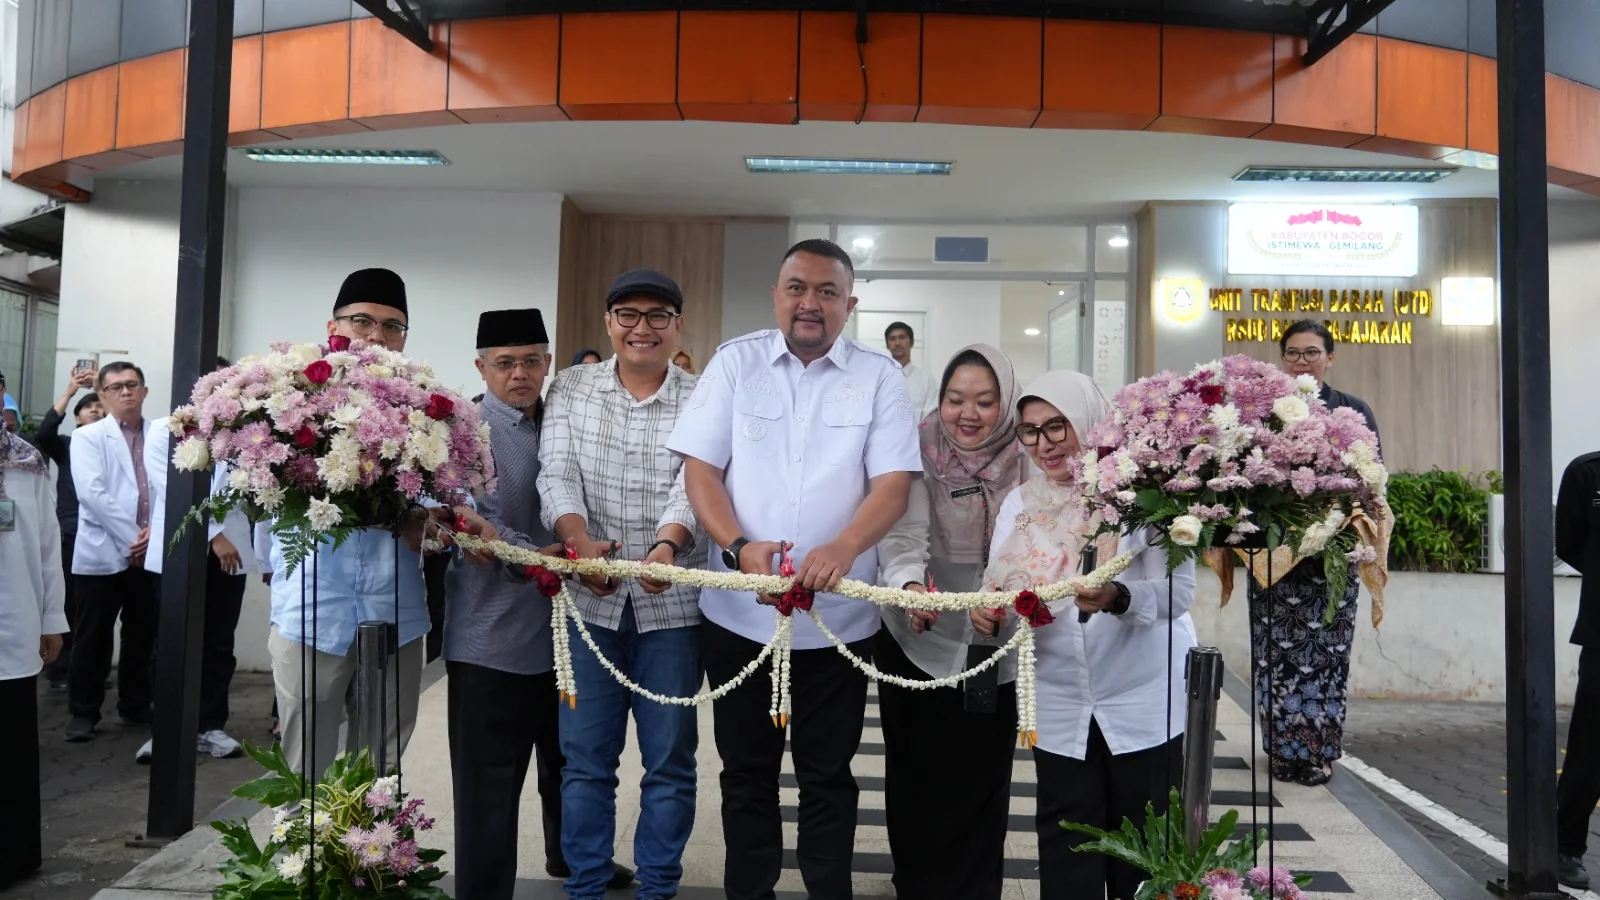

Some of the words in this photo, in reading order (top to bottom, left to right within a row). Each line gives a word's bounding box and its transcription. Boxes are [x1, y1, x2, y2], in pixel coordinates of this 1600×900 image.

[1270, 231, 1338, 240] KABUPATEN
[1341, 231, 1384, 241] BOGOR
[1267, 241, 1321, 249] ISTIMEWA
[1329, 241, 1384, 250] GEMILANG
[1209, 287, 1242, 312] UNIT
[1251, 288, 1325, 313] TRANFUSI
[1329, 288, 1384, 313] DARAH
[1393, 287, 1433, 318] (UTD)
[1227, 318, 1268, 342] RSUD
[1323, 319, 1412, 344] PAJAJARAN
